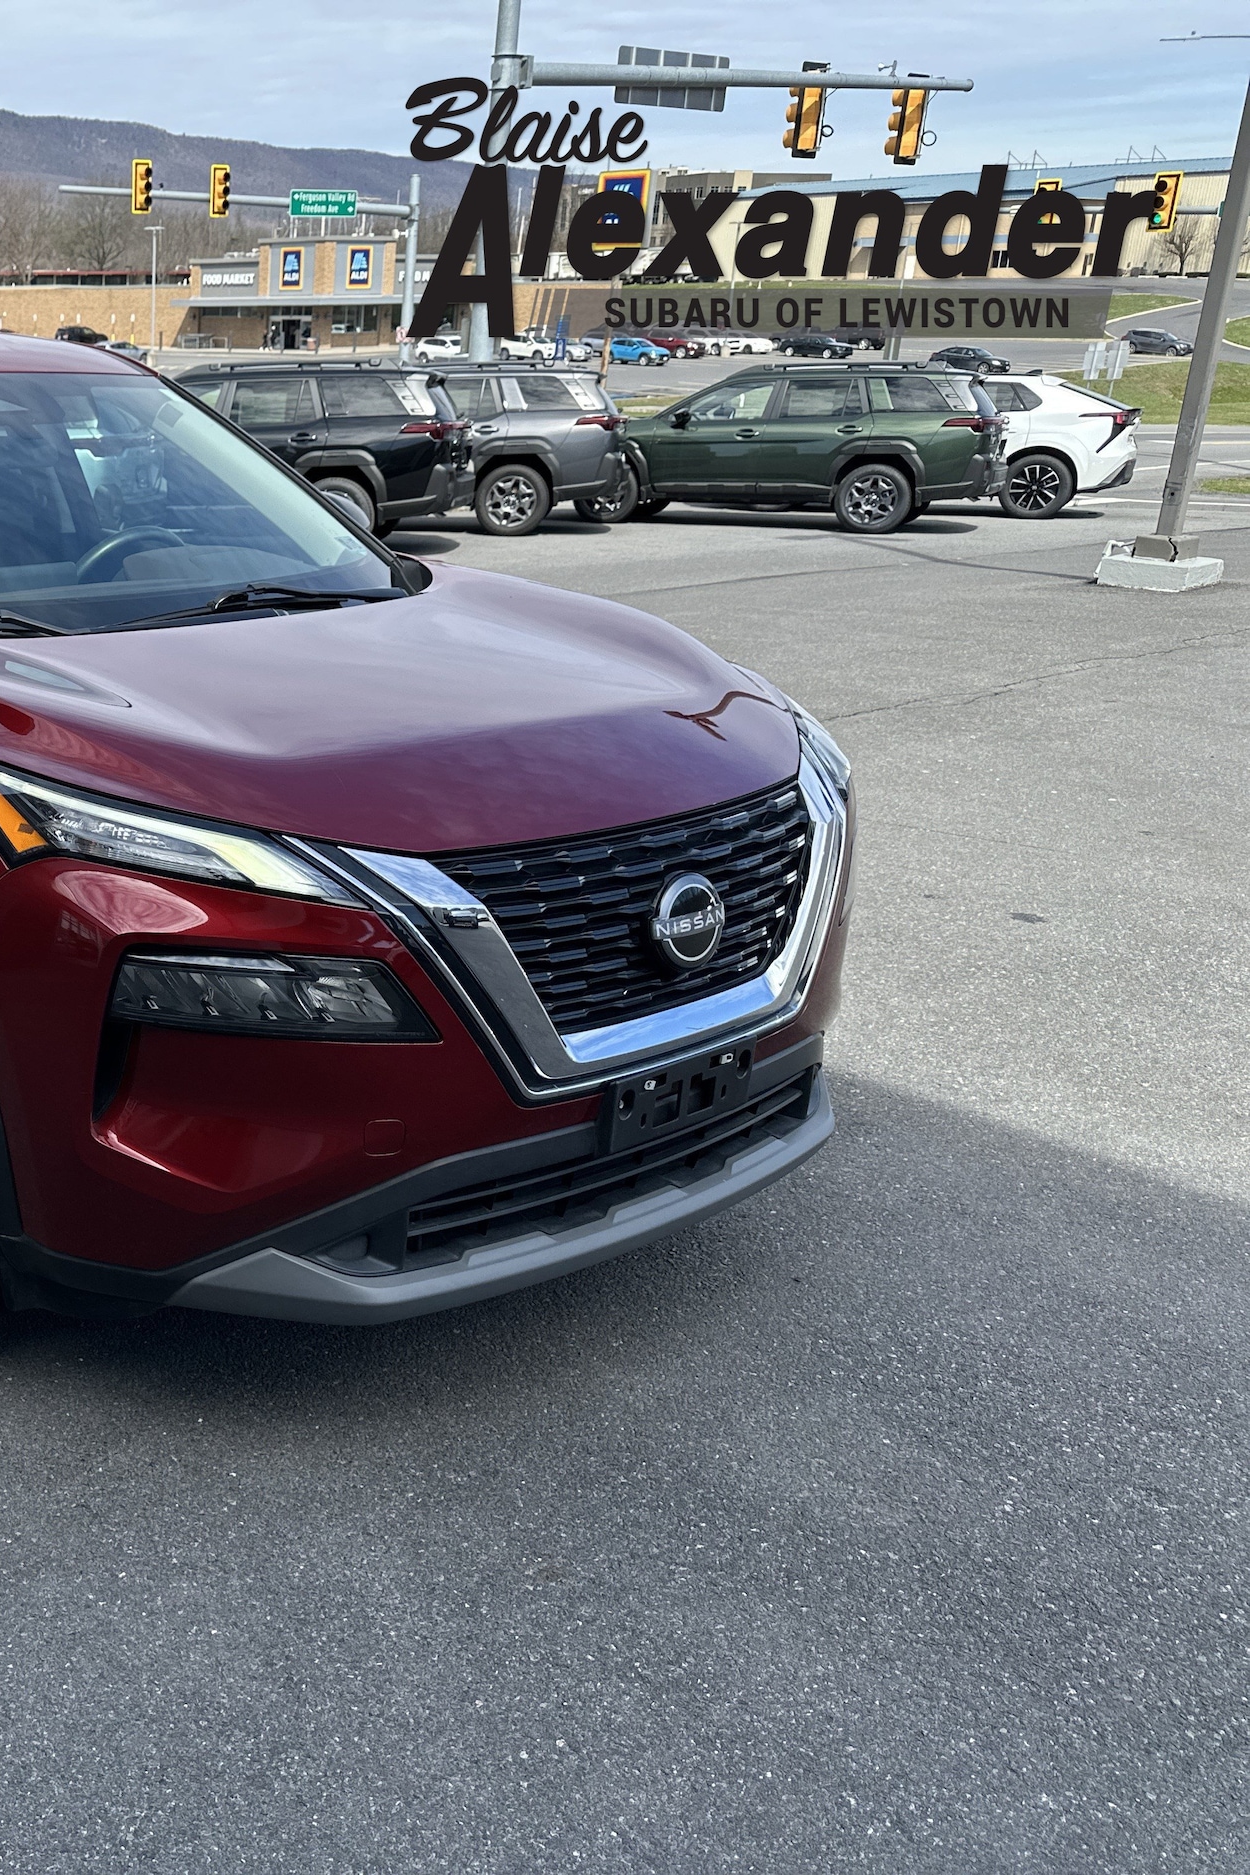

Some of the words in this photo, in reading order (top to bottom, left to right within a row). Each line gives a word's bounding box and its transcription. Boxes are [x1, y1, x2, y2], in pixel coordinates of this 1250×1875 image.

[299, 192, 327, 204] Ferguson
[327, 192, 347, 204] Valley
[301, 203, 327, 214] Freedom
[327, 204, 339, 214] Ave
[202, 274, 222, 285] FOOD
[222, 273, 255, 285] MARKET
[283, 273, 299, 281] ALDI
[350, 271, 368, 280] ALDI
[656, 908, 725, 938] NISSAN
